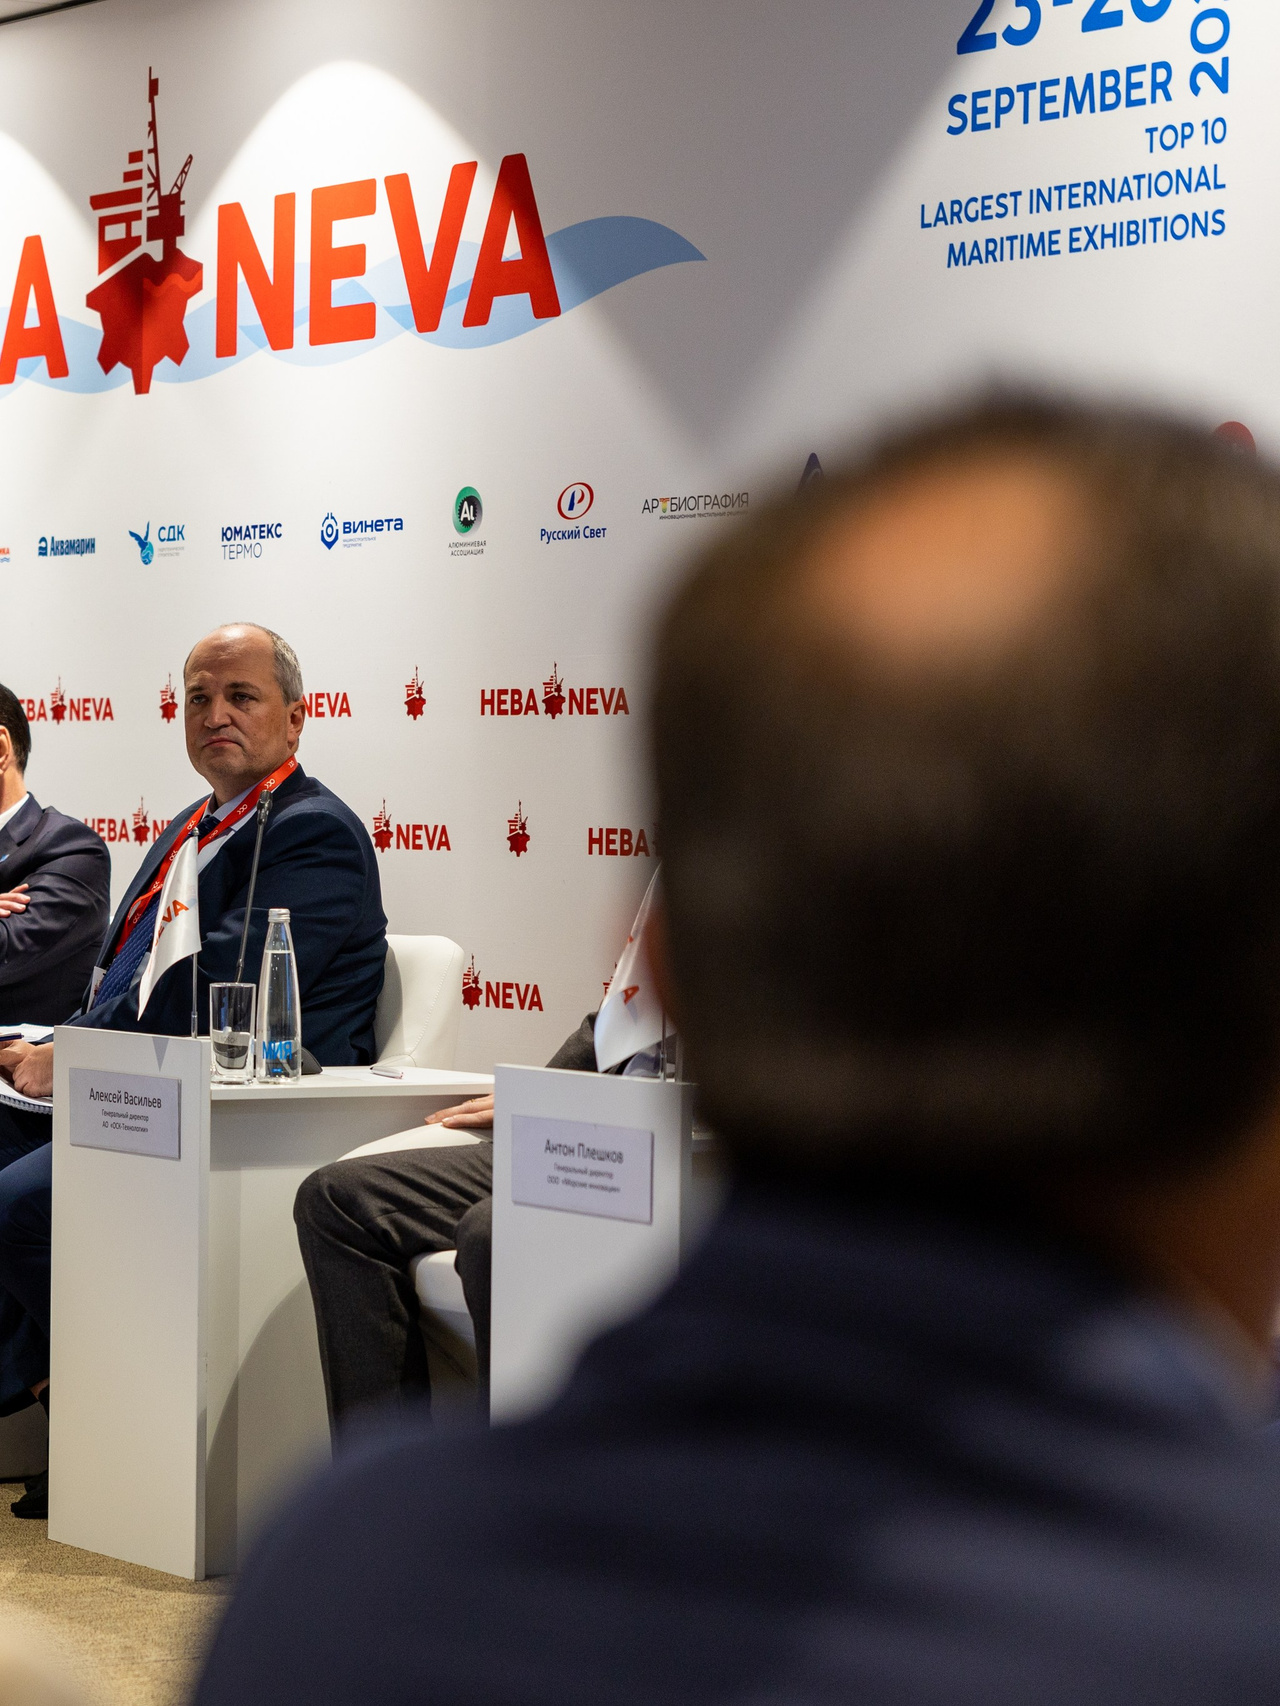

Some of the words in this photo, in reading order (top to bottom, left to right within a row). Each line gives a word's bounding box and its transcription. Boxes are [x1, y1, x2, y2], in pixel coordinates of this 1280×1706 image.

[1189, 0, 1230, 97] 20
[946, 60, 1173, 136] SEPTEMBER
[1145, 121, 1194, 153] TOP
[1201, 116, 1227, 145] 10
[921, 190, 1022, 229] LARGEST
[1029, 163, 1226, 214] INTERNATIONAL
[947, 229, 1061, 269] MARITIME
[1069, 208, 1226, 253] EXHIBITIONS
[215, 152, 562, 359] NEVA
[158, 524, 185, 543] СДК
[221, 522, 283, 542] ЮМАТЕКС
[448, 540, 487, 549] АЛЮМИНИЕВАЯ
[540, 525, 581, 545] Русский
[582, 526, 607, 539] Свет
[50, 535, 96, 557] Аквамарин
[221, 542, 263, 560] ТЕРМО
[450, 548, 484, 557] АССОЦИАЦИЯ
[19, 698, 48, 722] ВА
[69, 698, 114, 722] NEVA
[302, 692, 352, 718] NEVA
[480, 687, 539, 716] НЕВА
[568, 686, 630, 715] NEVA
[396, 824, 451, 851] NEVA
[588, 827, 651, 857] НЕВА
[485, 981, 544, 1012] NEVA
[89, 1087, 122, 1104] Алексей
[124, 1091, 162, 1109] Васильев
[101, 1108, 128, 1119] Генеральный
[129, 1113, 149, 1123] директор
[544, 1138, 575, 1158] Антон
[577, 1142, 624, 1164] Плешков
